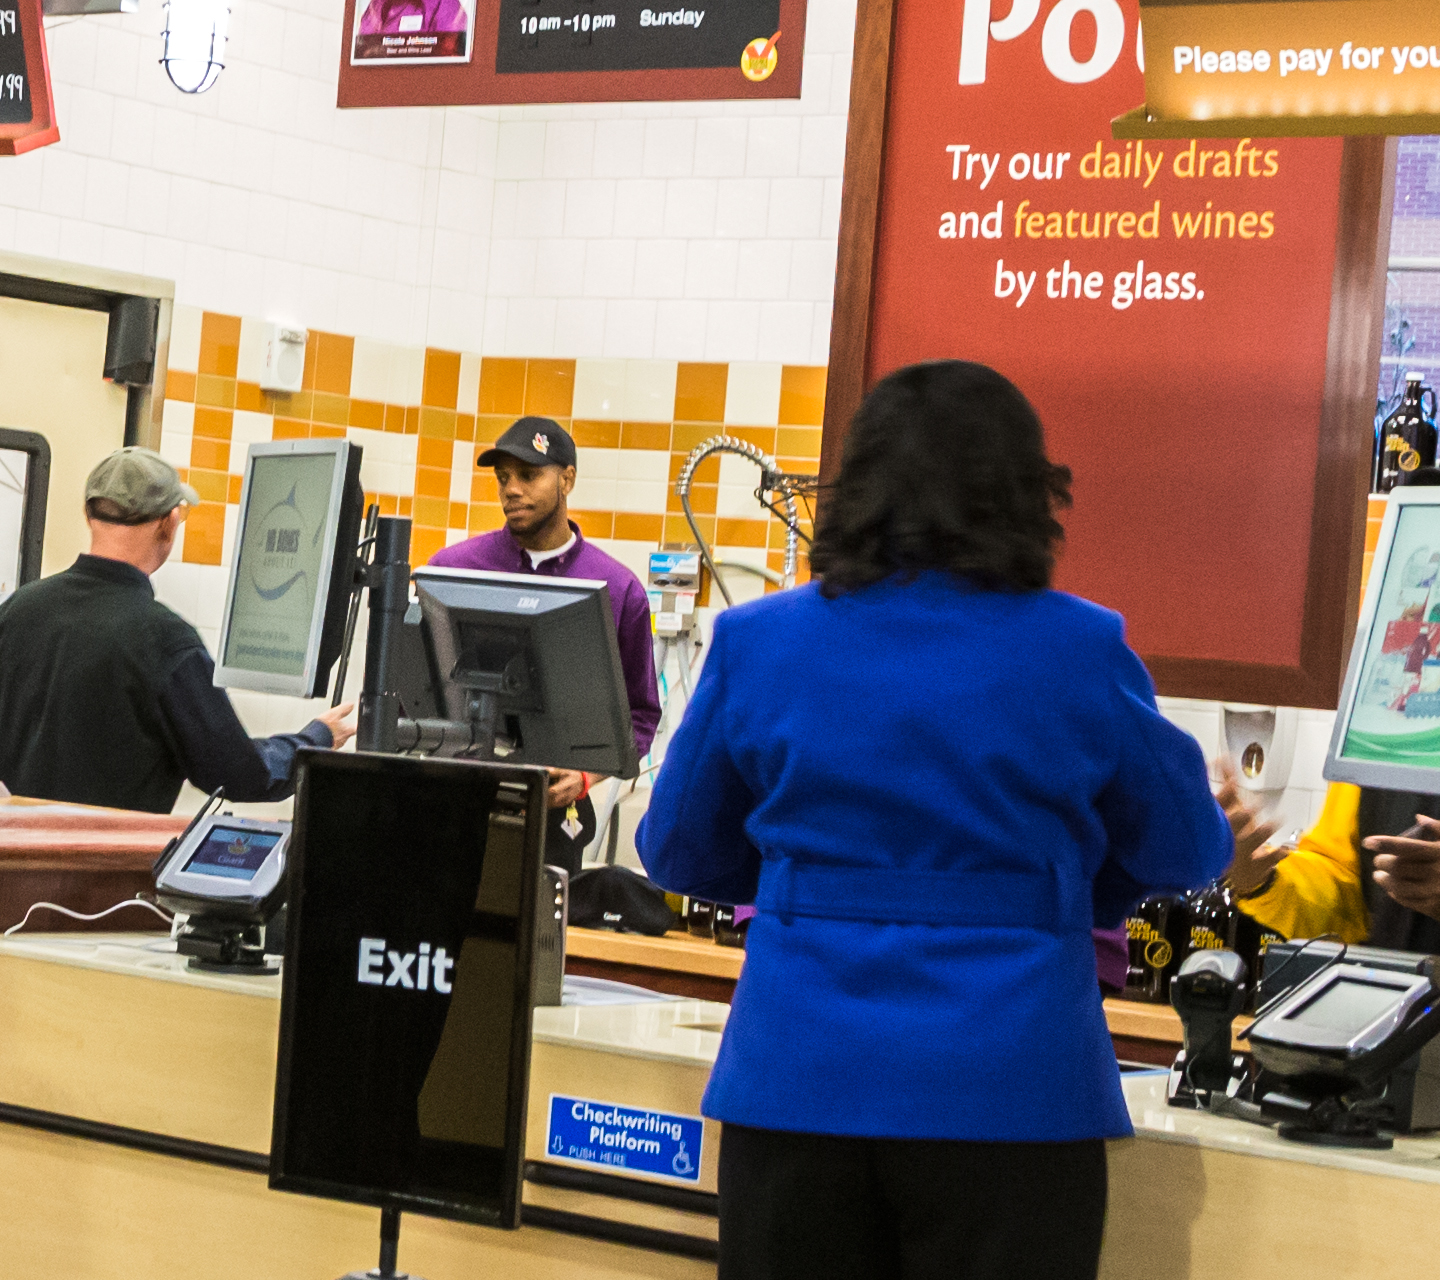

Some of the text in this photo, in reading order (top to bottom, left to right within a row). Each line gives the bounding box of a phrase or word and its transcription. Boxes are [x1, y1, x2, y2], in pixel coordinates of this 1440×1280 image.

[639, 9, 705, 29] Sunday
[1173, 42, 1271, 75] Please
[1279, 46, 1333, 77] pay
[1341, 41, 1384, 67] for
[945, 138, 1280, 190] Try our daily drafts
[937, 201, 1275, 241] and featured wines
[993, 258, 1207, 309] by the glass.
[517, 596, 539, 609] IBM
[358, 937, 454, 993] Exit
[571, 1102, 682, 1140] Checkwriting
[589, 1126, 661, 1155] Platform
